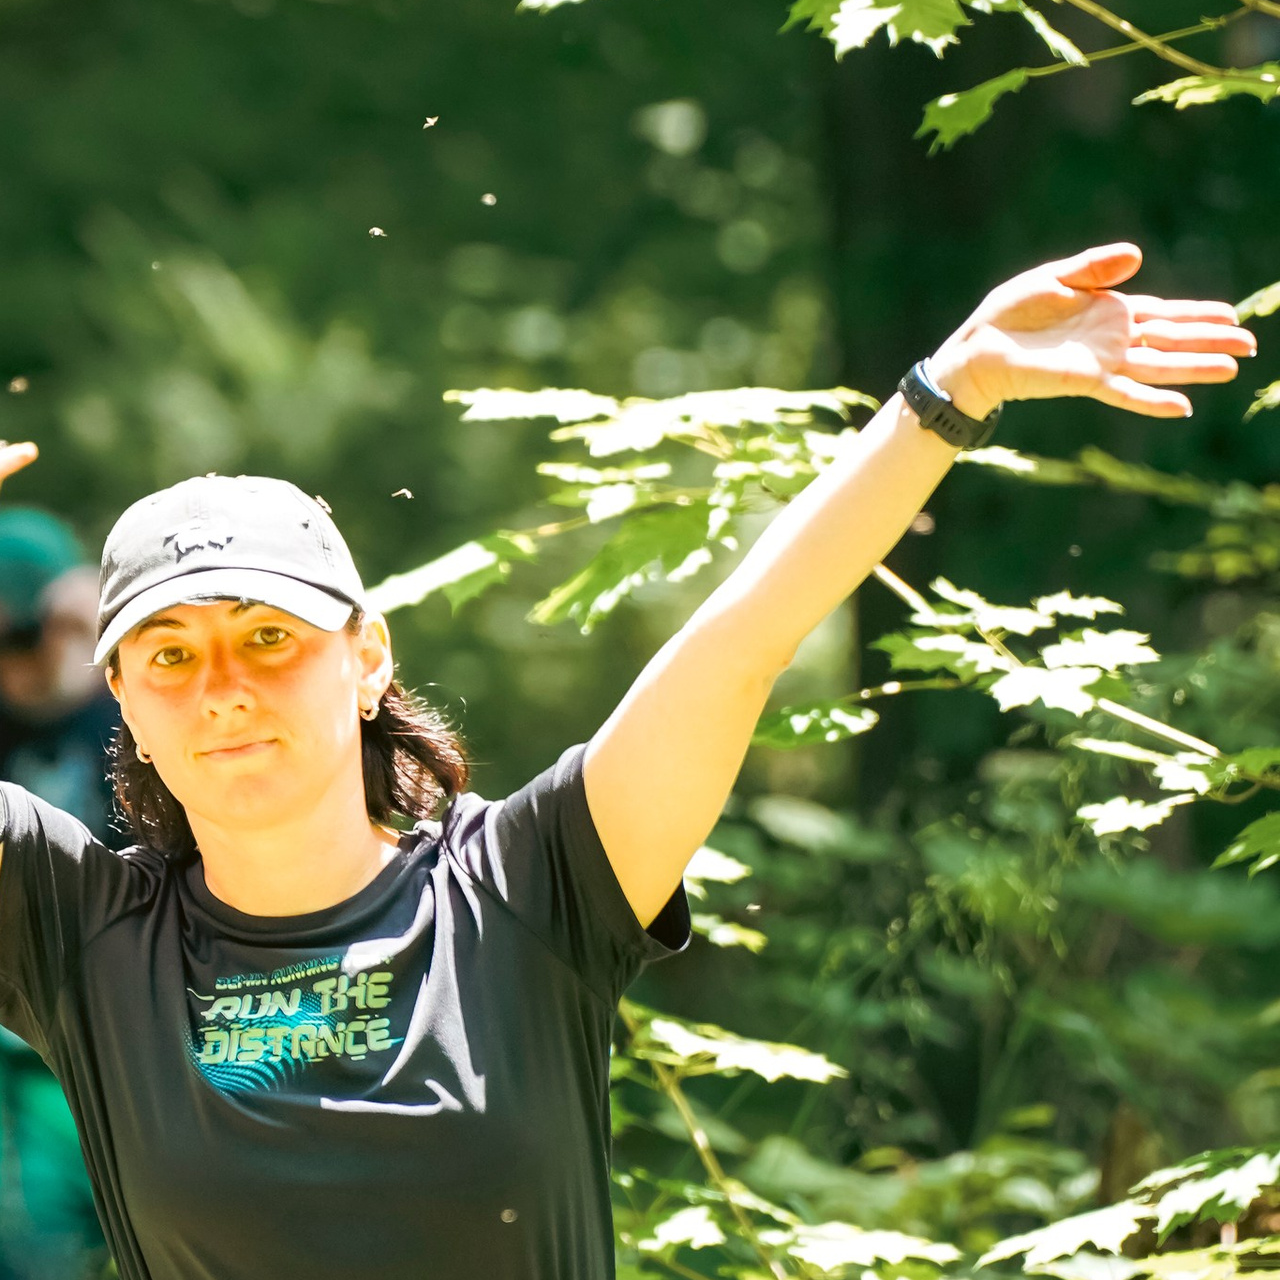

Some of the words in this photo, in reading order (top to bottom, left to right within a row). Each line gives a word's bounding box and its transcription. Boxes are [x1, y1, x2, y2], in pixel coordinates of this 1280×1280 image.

[201, 986, 303, 1021] RUN
[312, 971, 394, 1016] THE
[198, 1018, 392, 1065] DISTANCE
